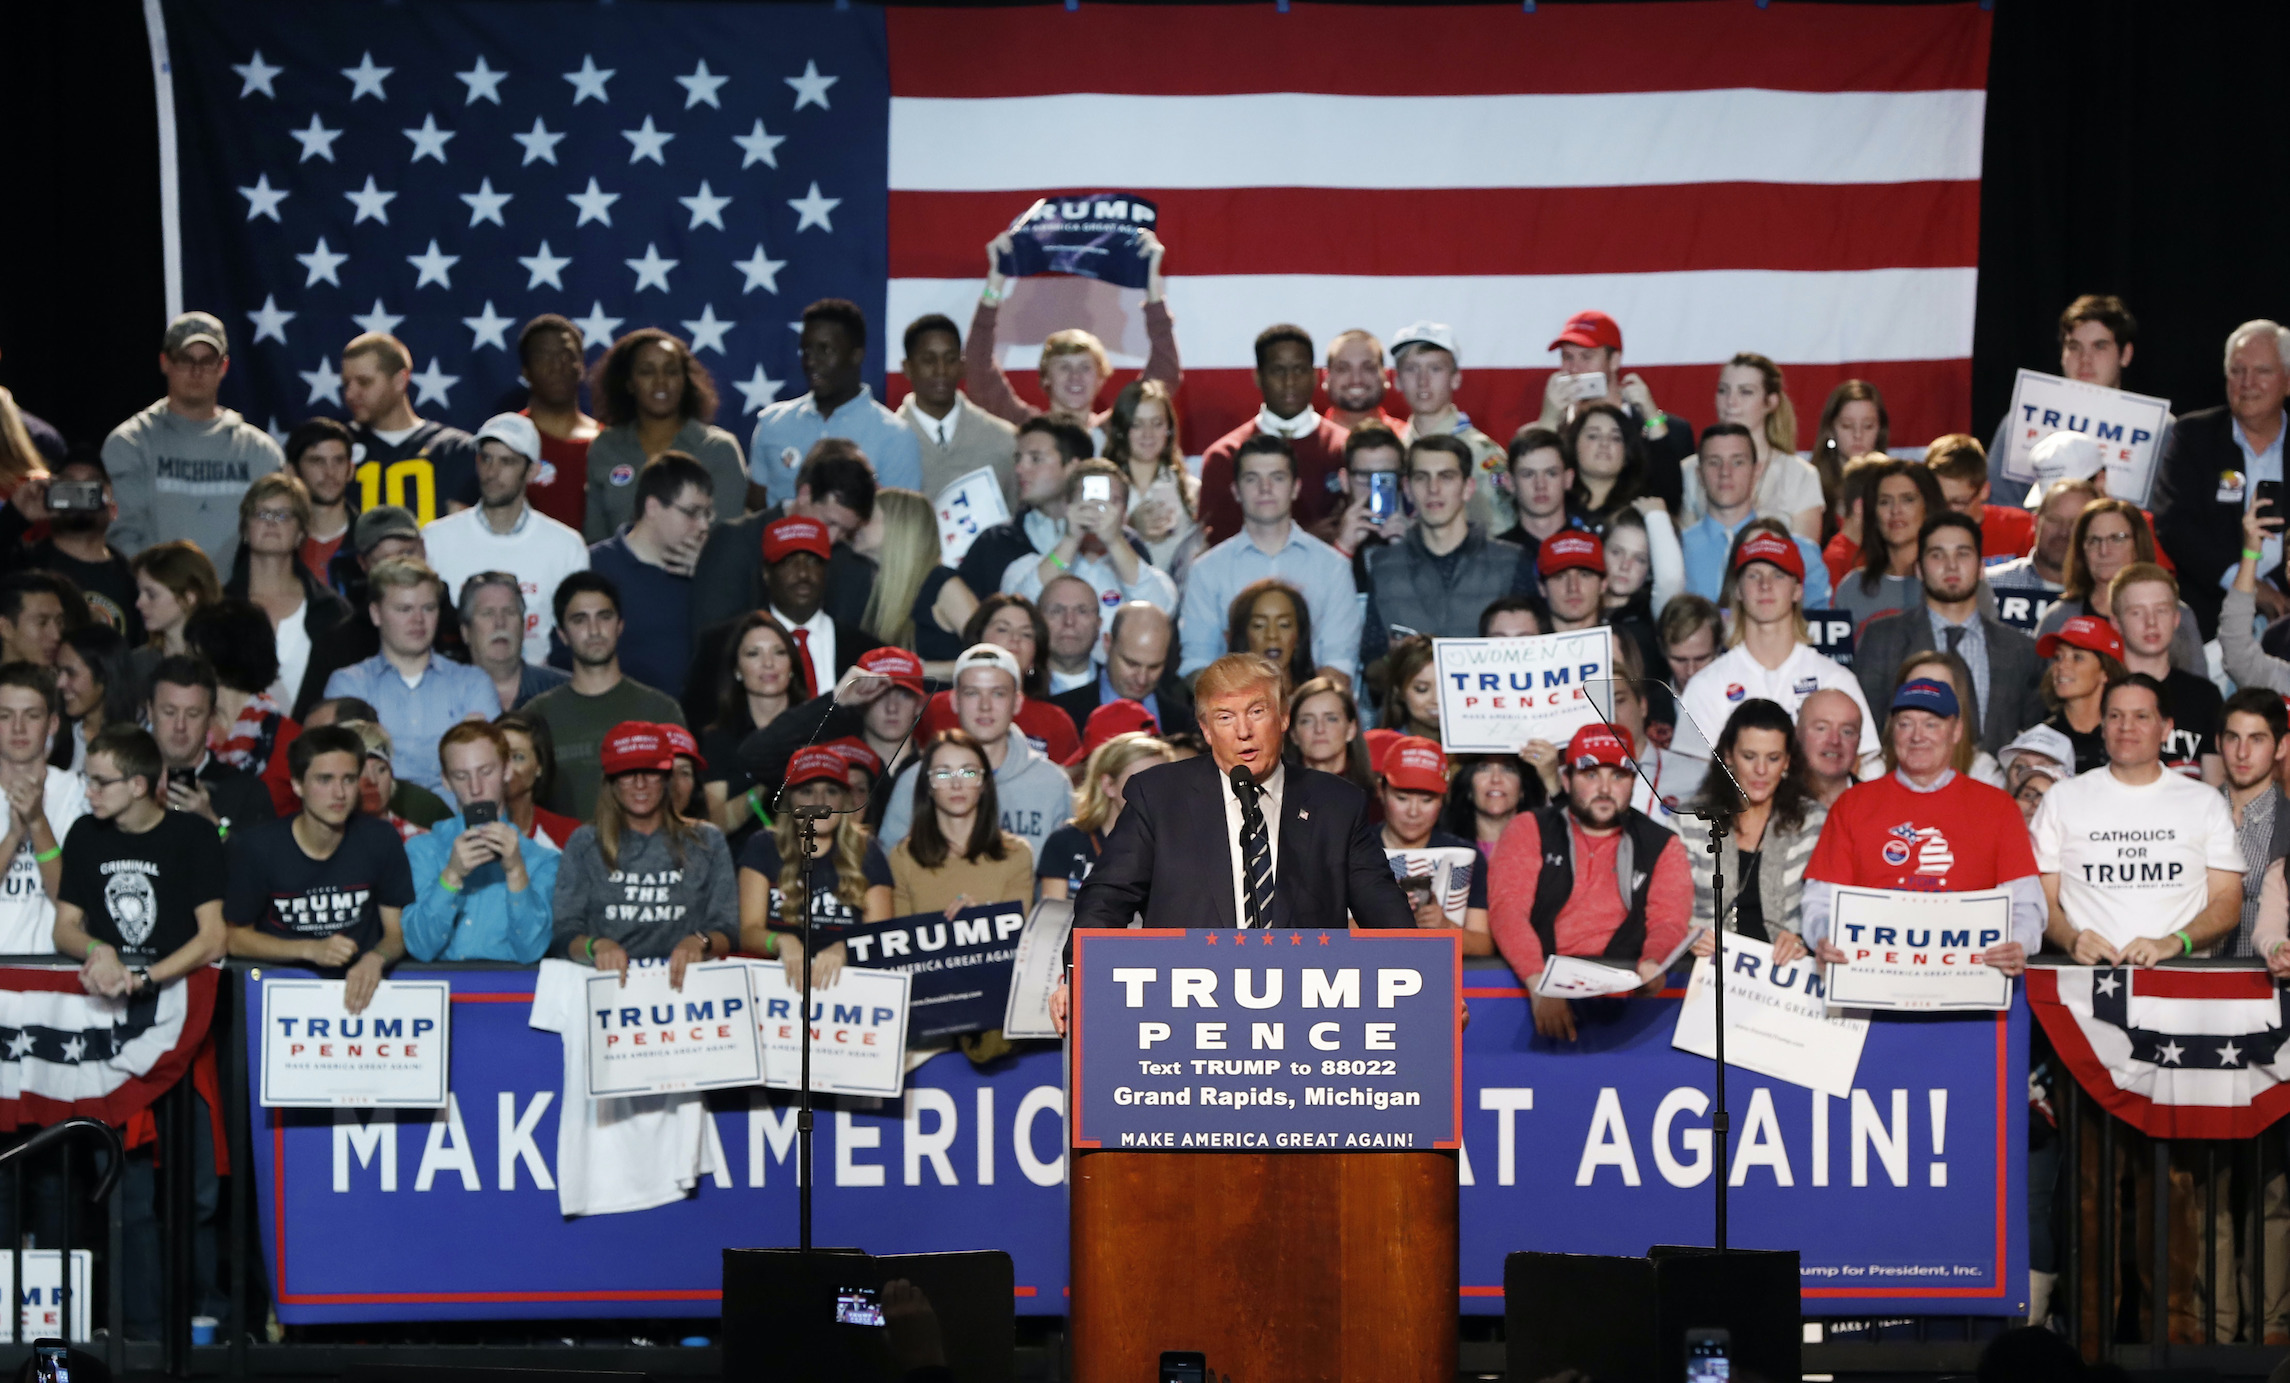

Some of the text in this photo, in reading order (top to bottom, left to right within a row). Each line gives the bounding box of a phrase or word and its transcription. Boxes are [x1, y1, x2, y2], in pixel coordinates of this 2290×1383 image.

[1030, 200, 1156, 222] RUMP
[2023, 404, 2150, 445] TRUMP
[157, 456, 250, 482] MICHIGAN
[356, 458, 435, 529] 10
[1467, 644, 1557, 664] WOMEN
[1450, 663, 1599, 691] TRUMP
[1466, 688, 1584, 708] PENCE
[1001, 811, 1042, 836] ALE
[2089, 829, 2176, 841] CATHOLICS
[2117, 847, 2148, 858] FOR
[12, 862, 33, 872] OR
[100, 859, 160, 877] CRIMINAL
[608, 869, 684, 886] DRAIN
[2082, 862, 2184, 883] TRUMP
[1908, 876, 1938, 887] FOR
[274, 890, 370, 914] TRUMP
[624, 886, 670, 902] THE
[605, 905, 687, 922] SWAMP
[847, 912, 1024, 962] TRUMP
[1845, 924, 2001, 948] TRUMP
[945, 953, 983, 970] GREAT
[1856, 950, 1984, 965] PENCE
[1112, 968, 1424, 1009] TRUMP
[596, 997, 744, 1030] TRUMP
[755, 998, 895, 1027] RUMP
[1730, 985, 1781, 1008] AMERICA
[1784, 1001, 1821, 1020] GREAT
[1824, 1015, 1864, 1033] AGAIN!
[277, 1018, 434, 1038] TRUMP
[607, 1025, 731, 1048] PENCE
[759, 1025, 877, 1046] ENCE
[1138, 1022, 1397, 1051] PENCE
[291, 1044, 418, 1057] PENCE
[1138, 1060, 1397, 1076] Text TRUMP to 88022
[1113, 1086, 1421, 1111] Grand Rapids, Michigan
[332, 1091, 556, 1192] MAK
[1576, 1087, 1948, 1188] AGAIN!
[1121, 1133, 1414, 1147] MAKE AMERICA GREAT AGAIN!
[1800, 1264, 1983, 1278] ump for President, Inc.
